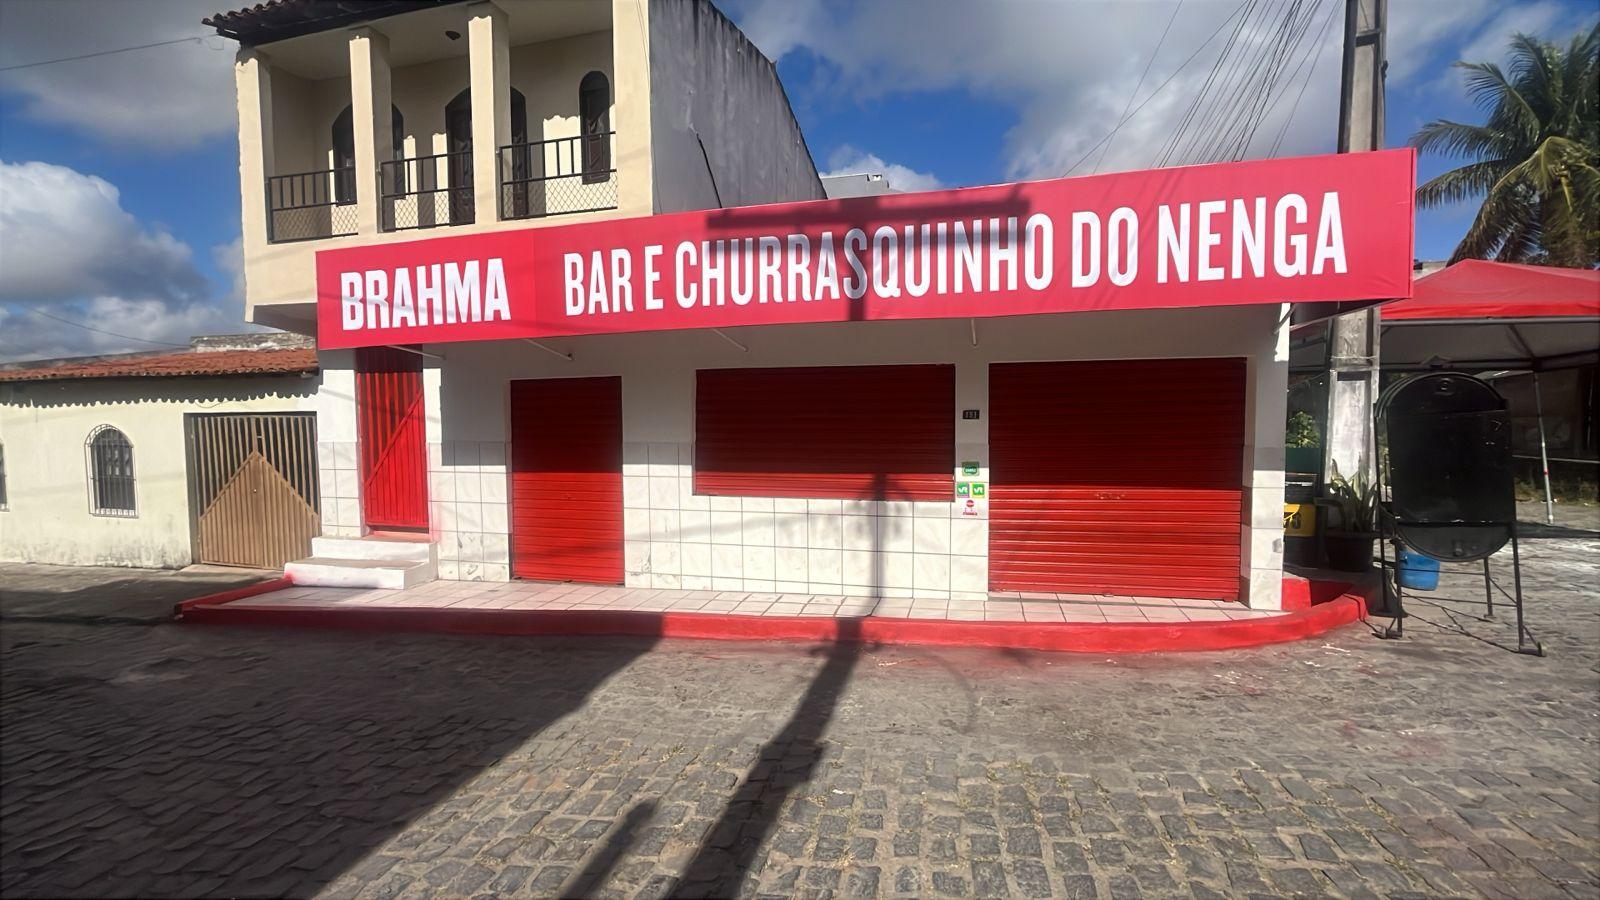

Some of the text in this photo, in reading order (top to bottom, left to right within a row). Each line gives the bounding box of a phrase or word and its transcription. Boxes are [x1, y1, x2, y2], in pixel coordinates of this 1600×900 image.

[340, 257, 511, 331] BRAHMA
[563, 191, 1348, 316] BAR E CHURRASQUINHO DO NENGA
